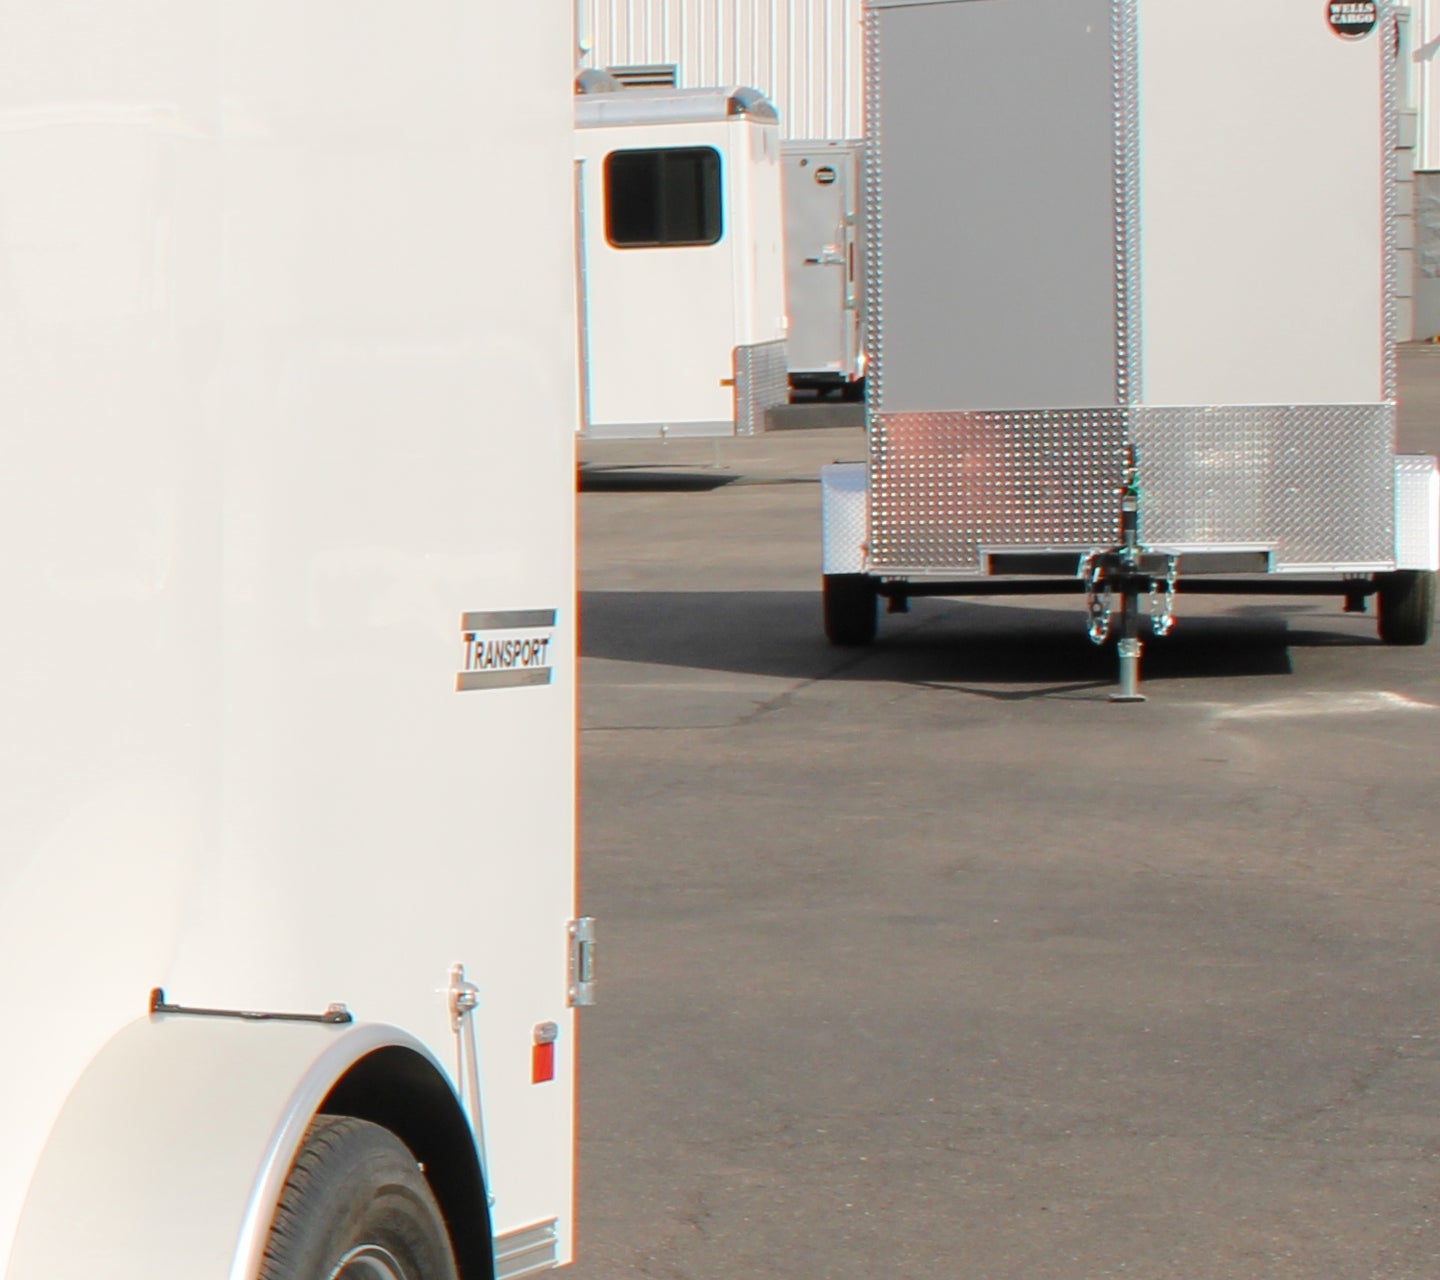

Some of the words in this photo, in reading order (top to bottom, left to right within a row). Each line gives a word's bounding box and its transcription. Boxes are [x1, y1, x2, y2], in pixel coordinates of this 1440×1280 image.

[1330, 3, 1374, 13] WELLS
[1330, 14, 1374, 23] CARGO
[464, 633, 549, 670] TRANSPORT
